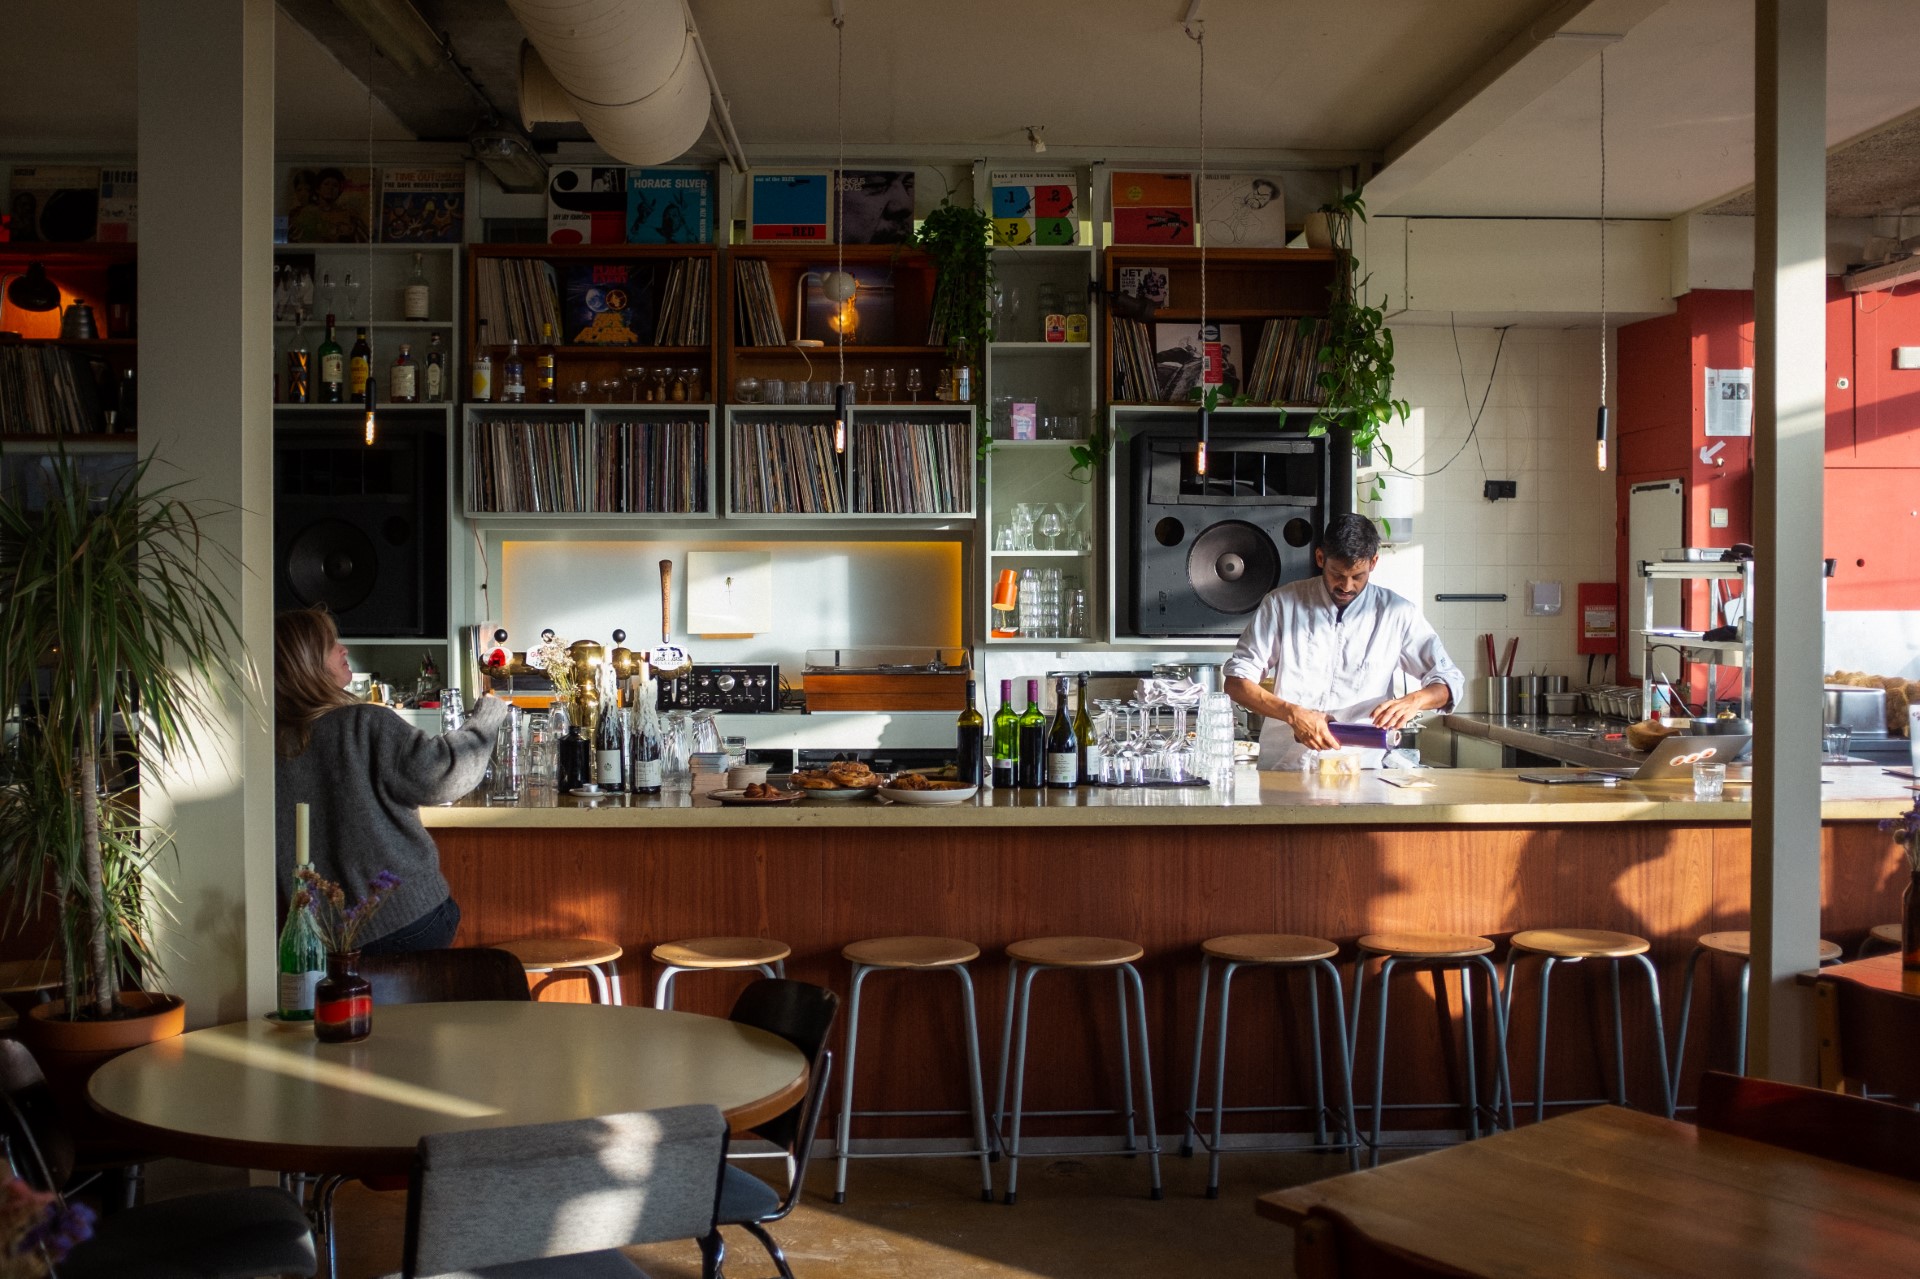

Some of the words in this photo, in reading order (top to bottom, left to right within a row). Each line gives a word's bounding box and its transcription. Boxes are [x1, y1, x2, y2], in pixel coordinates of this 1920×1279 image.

[395, 172, 416, 181] TIME
[417, 172, 435, 181] OUT
[634, 178, 672, 189] HORACE
[675, 178, 708, 189] SILVER
[792, 226, 815, 236] RED
[1122, 268, 1143, 277] JET
